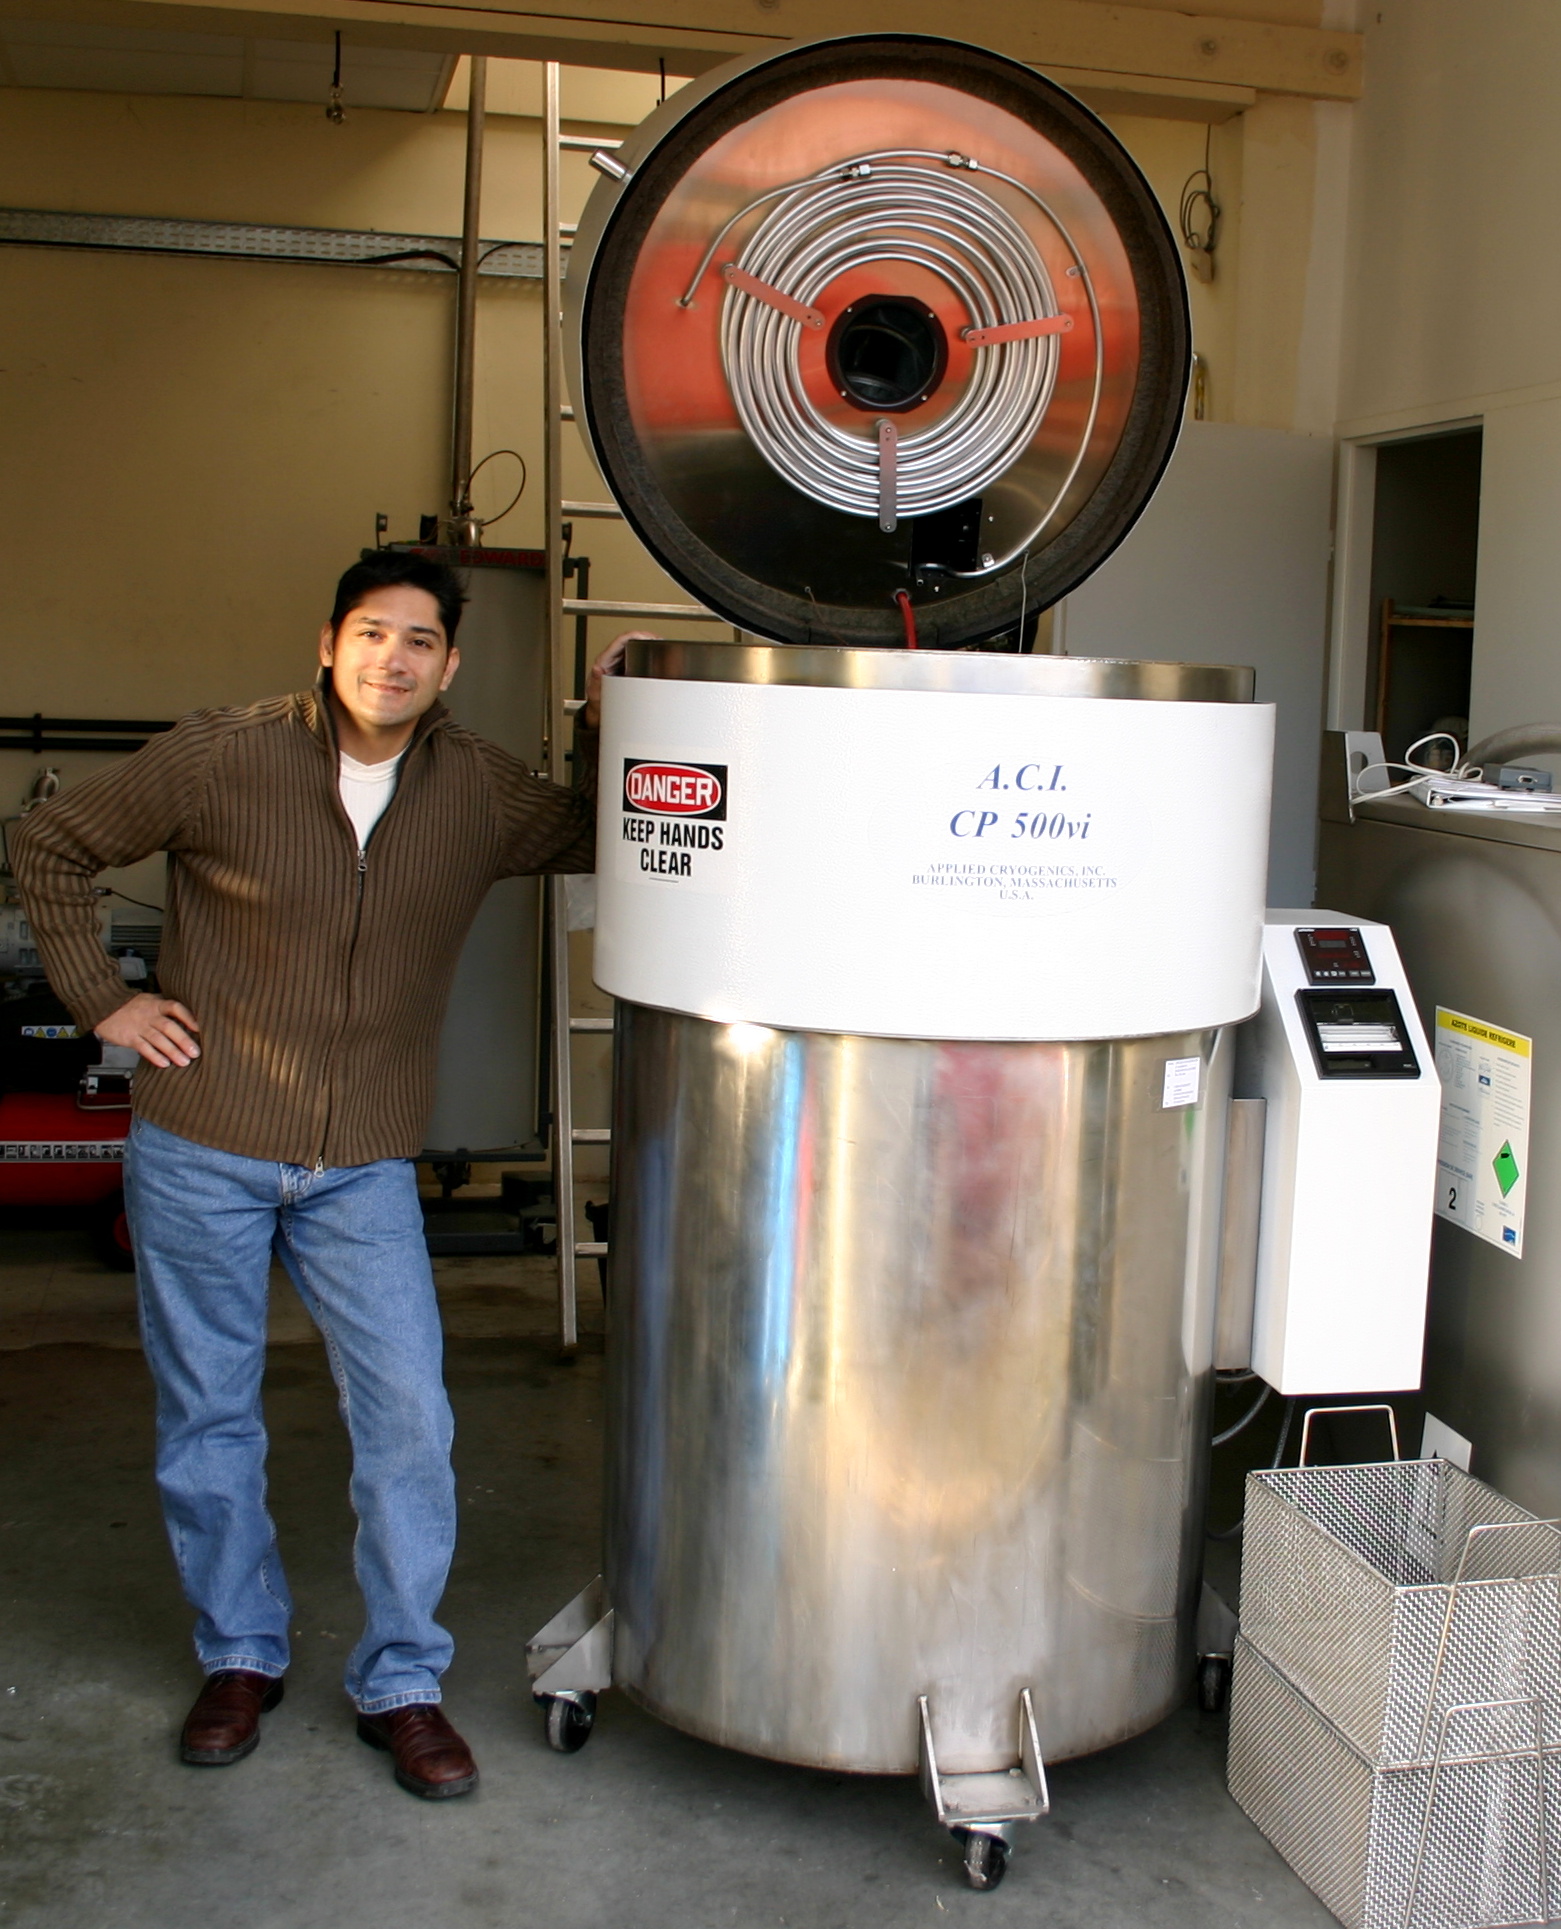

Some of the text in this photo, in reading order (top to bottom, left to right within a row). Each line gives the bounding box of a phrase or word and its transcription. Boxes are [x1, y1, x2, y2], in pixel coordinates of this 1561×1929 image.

[460, 549, 546, 567] EDWARD
[631, 772, 712, 807] DANGER
[975, 763, 1066, 791] A.C.I.
[622, 817, 723, 850] KEEP HANDS
[950, 810, 1091, 839] CP 500vi
[640, 848, 692, 877] CLEAR
[926, 863, 1106, 877] APPLIED CRYOGENICS, INC.
[912, 874, 1117, 888] BURLINGTON, MASSACHUSETTS
[999, 889, 1034, 900] U.S.A.
[1448, 1187, 1457, 1210] 2
